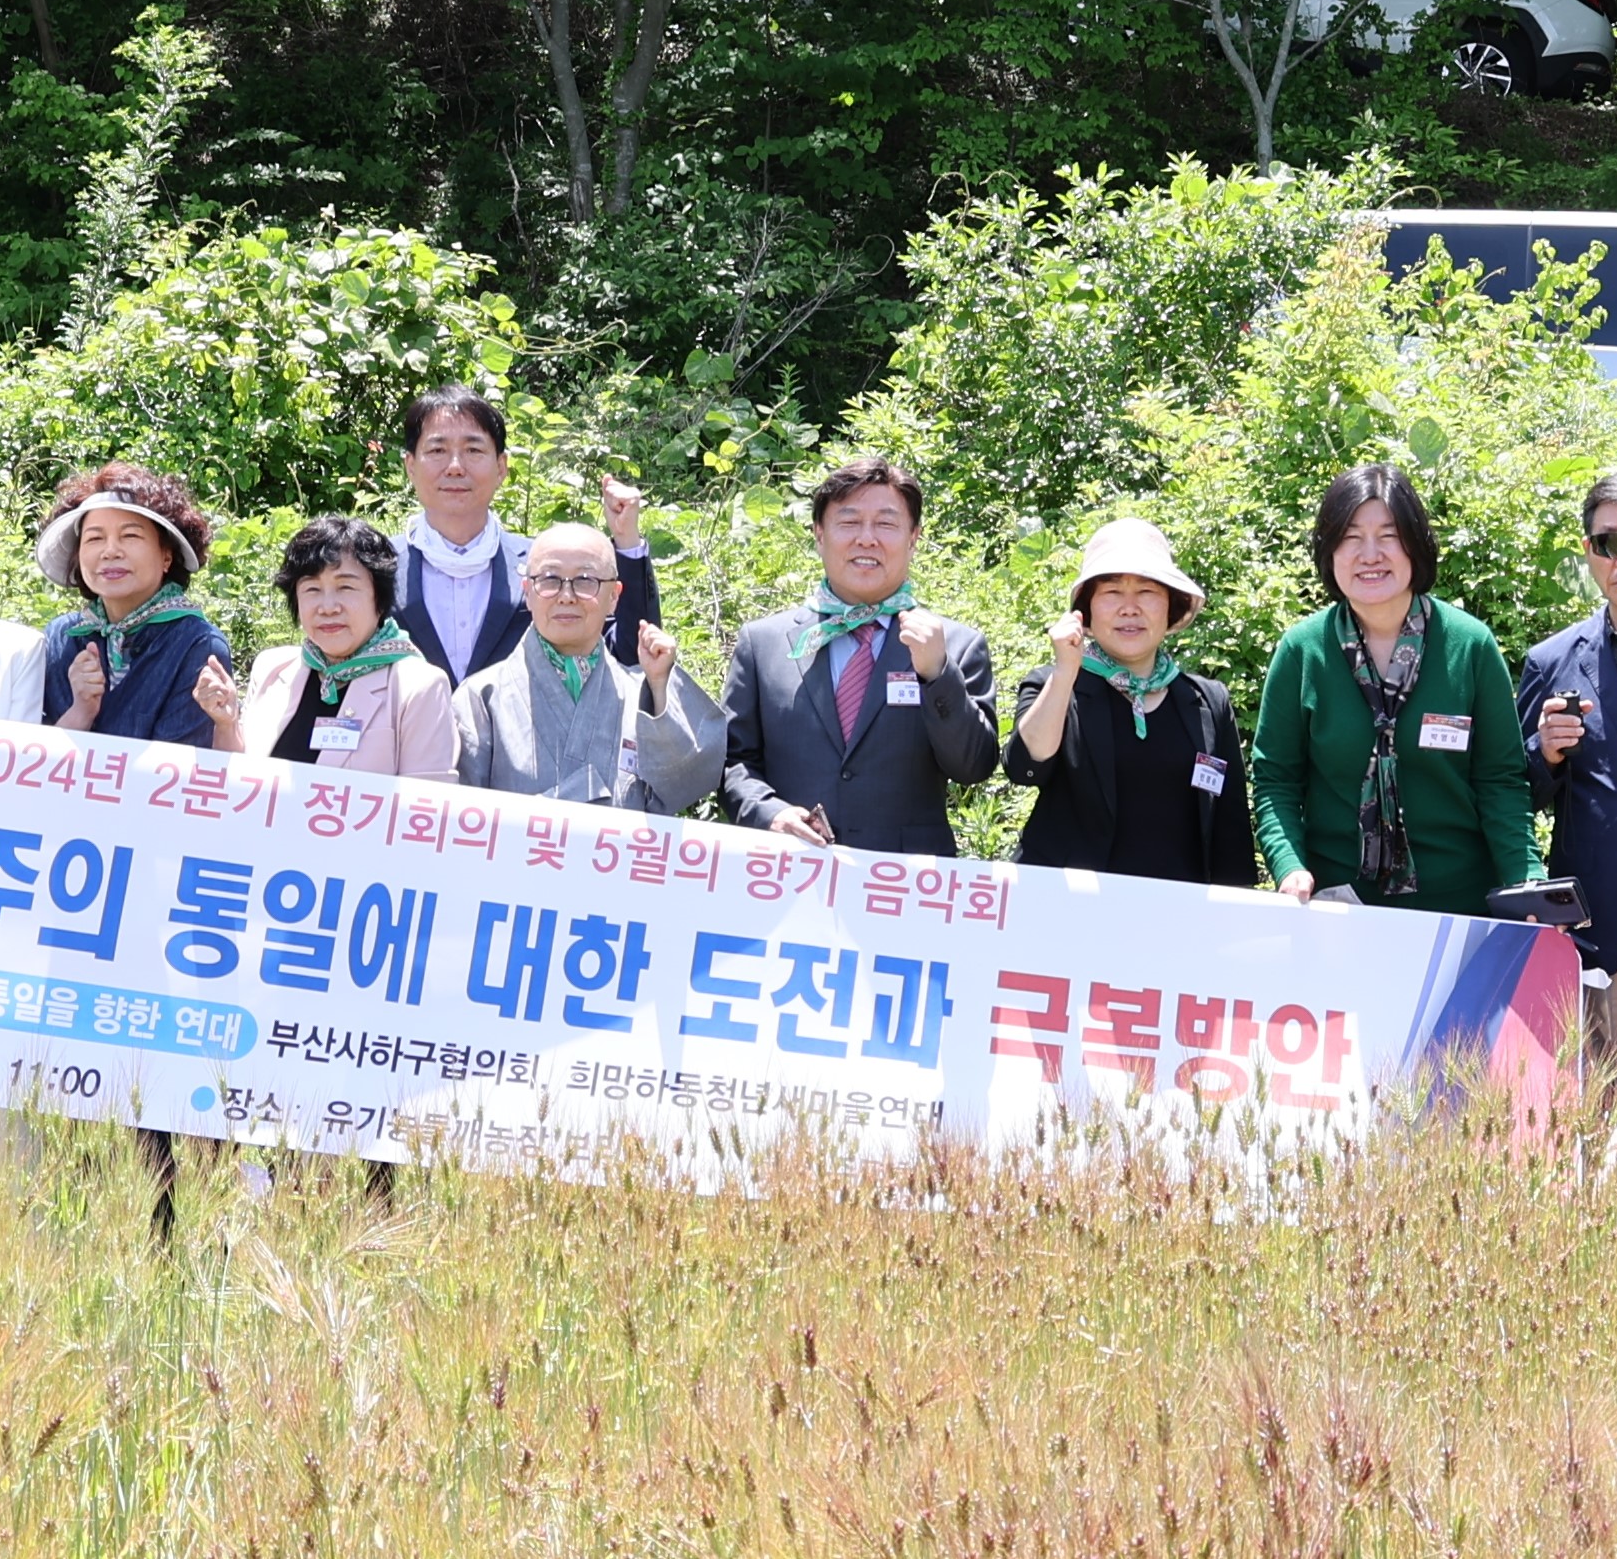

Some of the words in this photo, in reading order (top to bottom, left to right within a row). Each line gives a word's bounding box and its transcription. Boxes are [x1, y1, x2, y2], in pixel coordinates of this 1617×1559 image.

[148, 762, 281, 828] 2분기
[304, 782, 498, 861] 정기회의
[525, 817, 567, 873] 및
[591, 827, 724, 893] 5월의
[744, 844, 840, 909] 향기
[862, 862, 1010, 930] 음악회
[164, 854, 438, 1006] 통일에
[467, 902, 651, 1031] 대한
[678, 930, 953, 1069] 도전과
[988, 969, 1353, 1110] 극복방안
[93, 991, 162, 1040] 향한
[174, 1006, 244, 1053] 연대
[10, 1057, 102, 1099] 11:00
[221, 1086, 283, 1124] 장소
